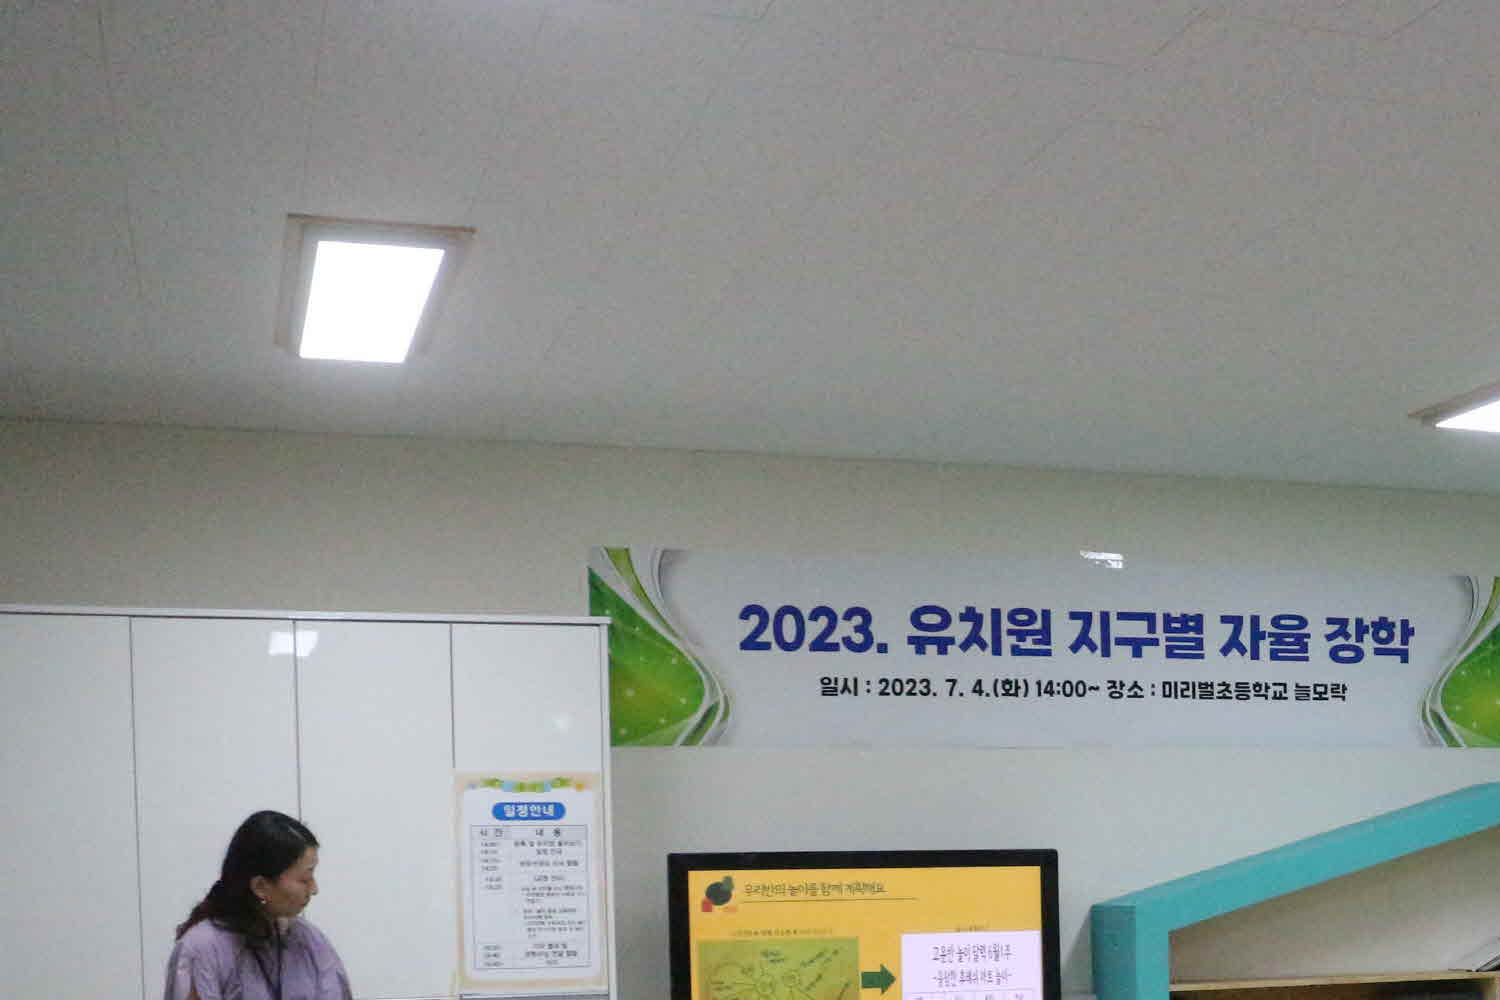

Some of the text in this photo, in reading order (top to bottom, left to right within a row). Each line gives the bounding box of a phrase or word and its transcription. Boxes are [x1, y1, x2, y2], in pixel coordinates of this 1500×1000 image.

[739, 604, 1415, 664] 2023. 유치원 지구별 자율 장학
[820, 677, 858, 697] 일시
[878, 678, 938, 697] 2023.
[945, 679, 964, 697] 7.
[1107, 680, 1145, 700] 장소
[1162, 681, 1289, 701] 미리벌초등학교
[1294, 683, 1348, 701] 늘모락
